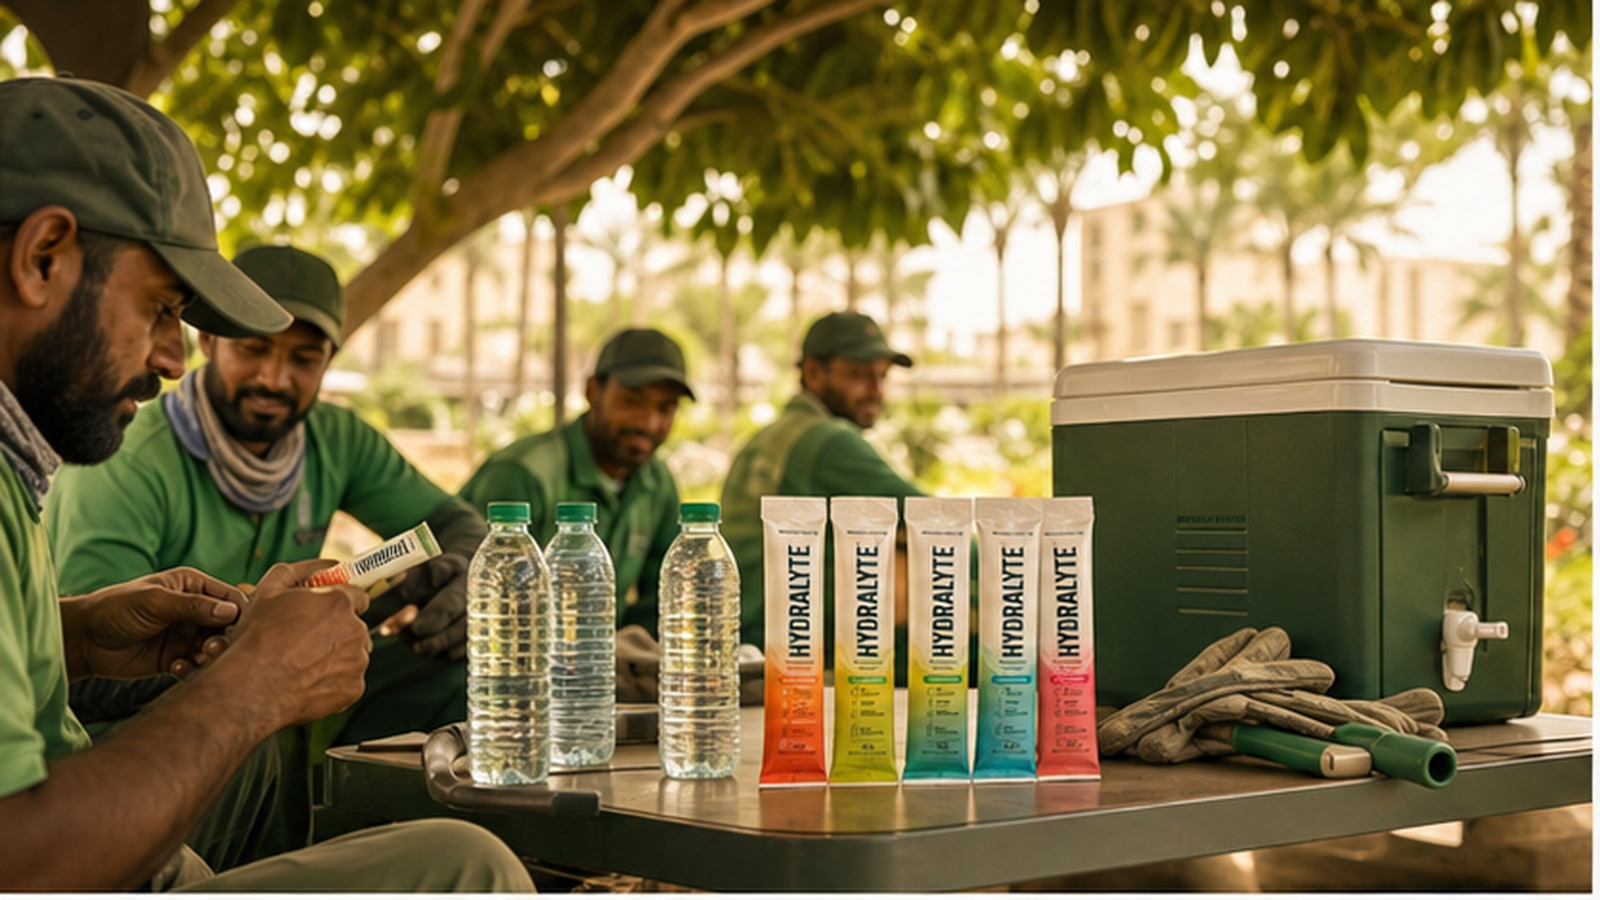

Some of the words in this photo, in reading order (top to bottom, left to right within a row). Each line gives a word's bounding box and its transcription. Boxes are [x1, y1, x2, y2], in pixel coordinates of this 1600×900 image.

[788, 545, 811, 658] HYDRALYTE
[856, 545, 879, 658] HYDRALYTE
[932, 546, 955, 658] HYDRALYTE
[1001, 546, 1025, 658] HYDRALYTE
[1053, 546, 1080, 658] HYDRALYTE
